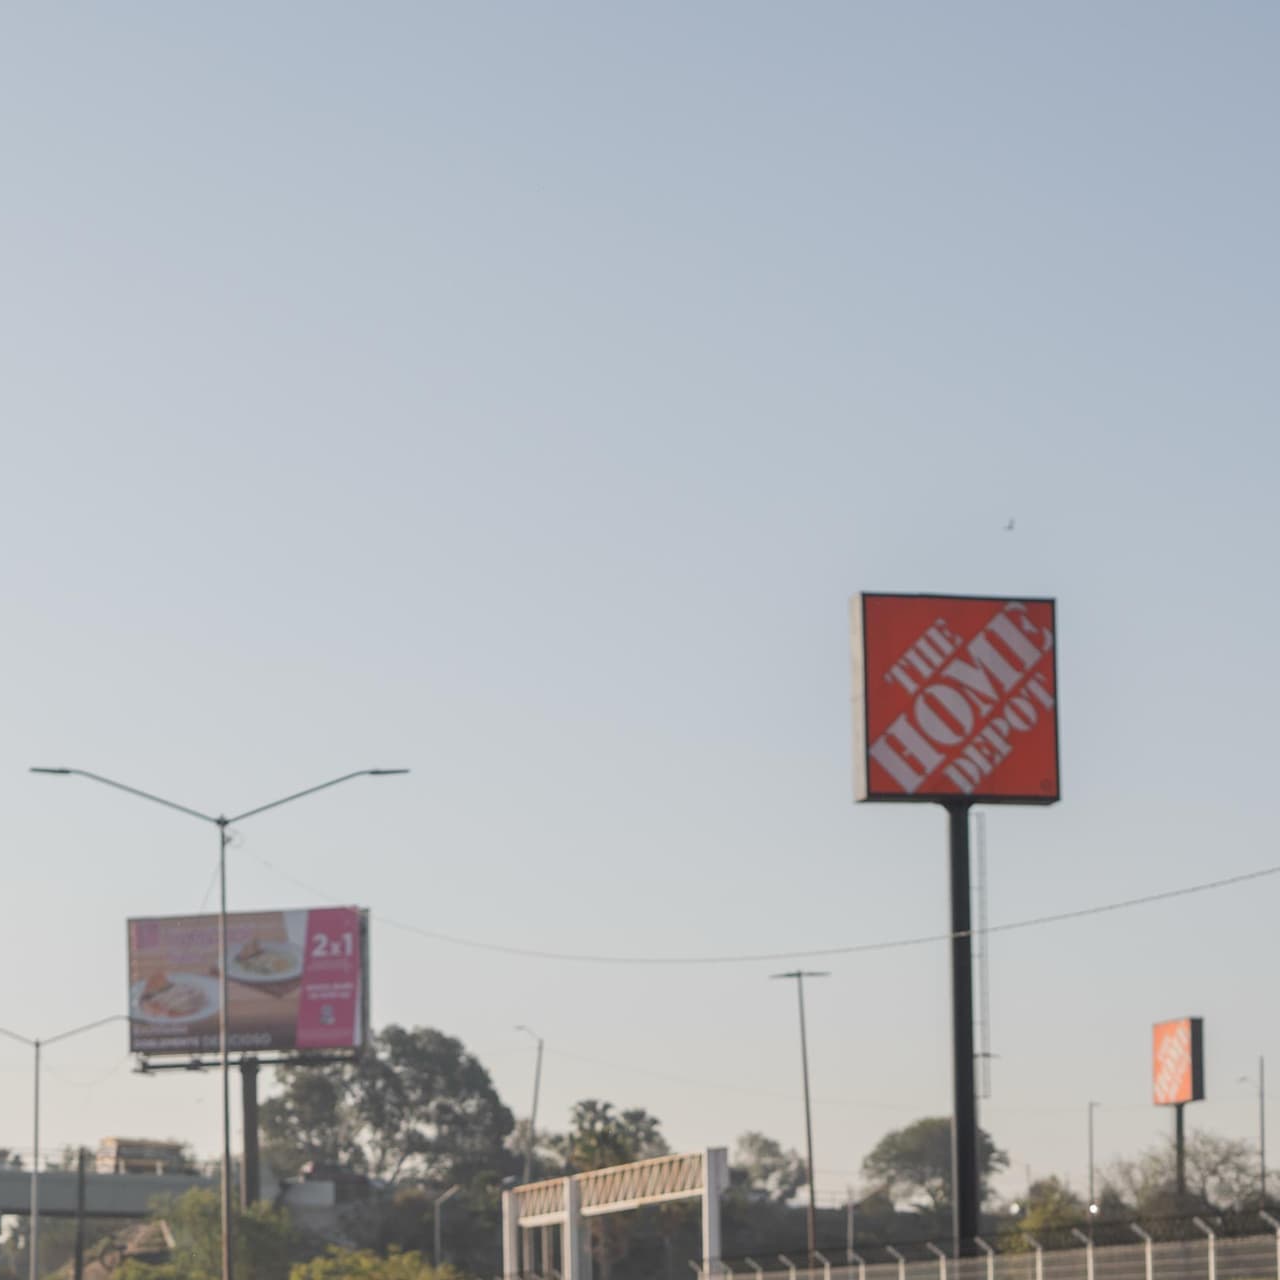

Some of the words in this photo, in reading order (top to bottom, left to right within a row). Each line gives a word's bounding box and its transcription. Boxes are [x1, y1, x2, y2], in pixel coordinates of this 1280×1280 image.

[869, 601, 1054, 795] HOME
[883, 617, 964, 695] THE
[943, 671, 1055, 795] DEPOT
[311, 933, 352, 957] 2x1
